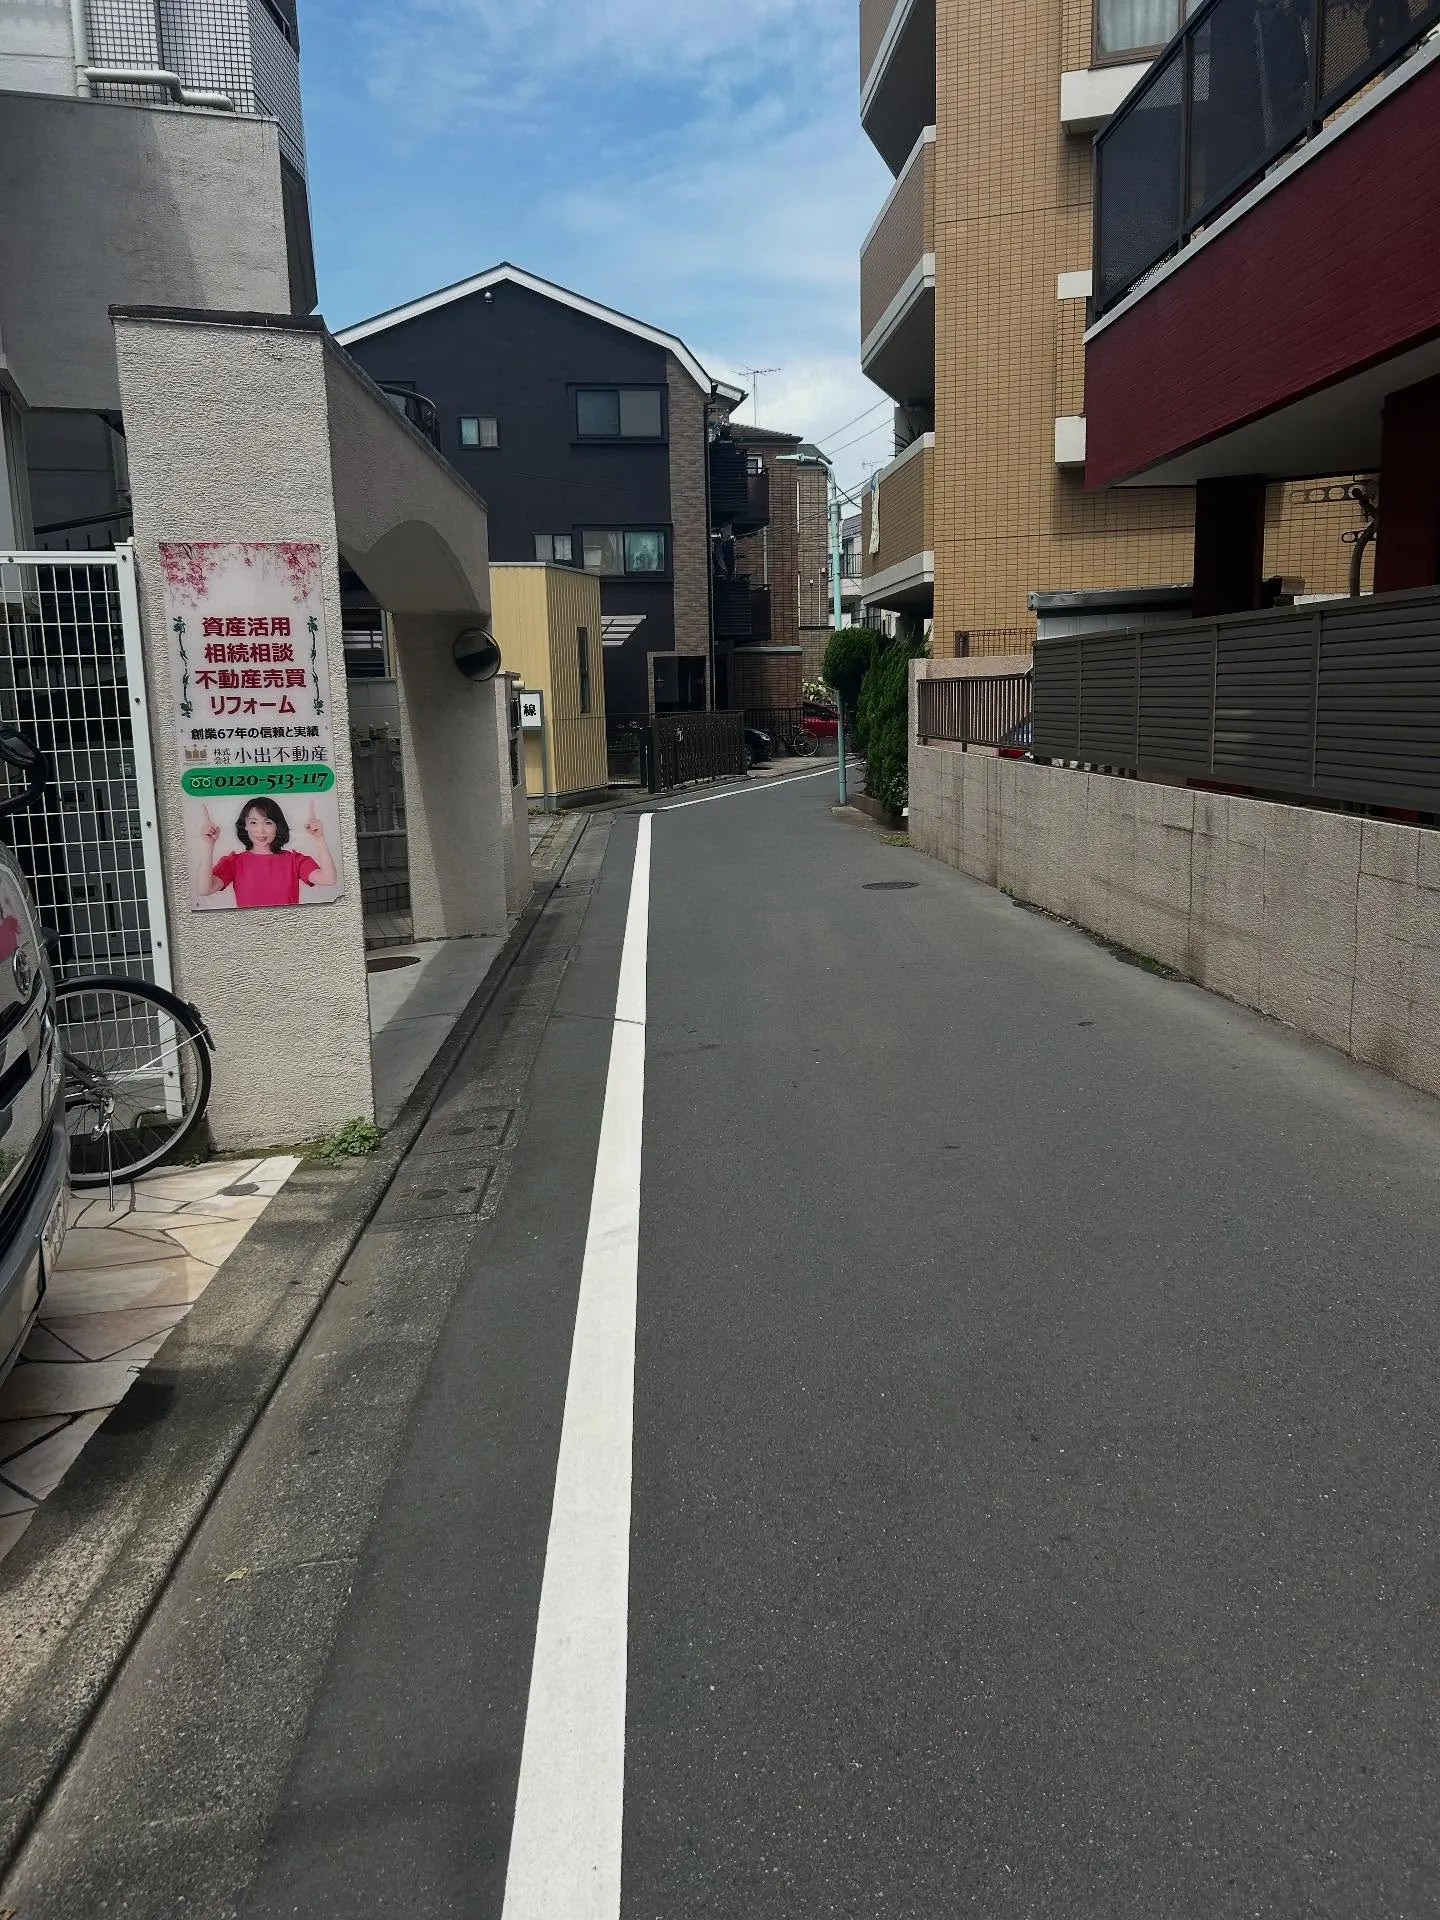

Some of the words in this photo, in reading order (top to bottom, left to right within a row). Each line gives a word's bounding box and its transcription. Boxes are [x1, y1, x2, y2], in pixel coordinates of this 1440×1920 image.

[202, 616, 291, 637] 資産活用
[204, 642, 294, 663] 相続相談
[195, 668, 307, 689] 不動産売買
[210, 694, 296, 715] リフォーム
[191, 725, 320, 741] 創業67年の信頼と実績
[234, 744, 328, 764] 小出不動産
[214, 772, 328, 790] 0120-513-117
